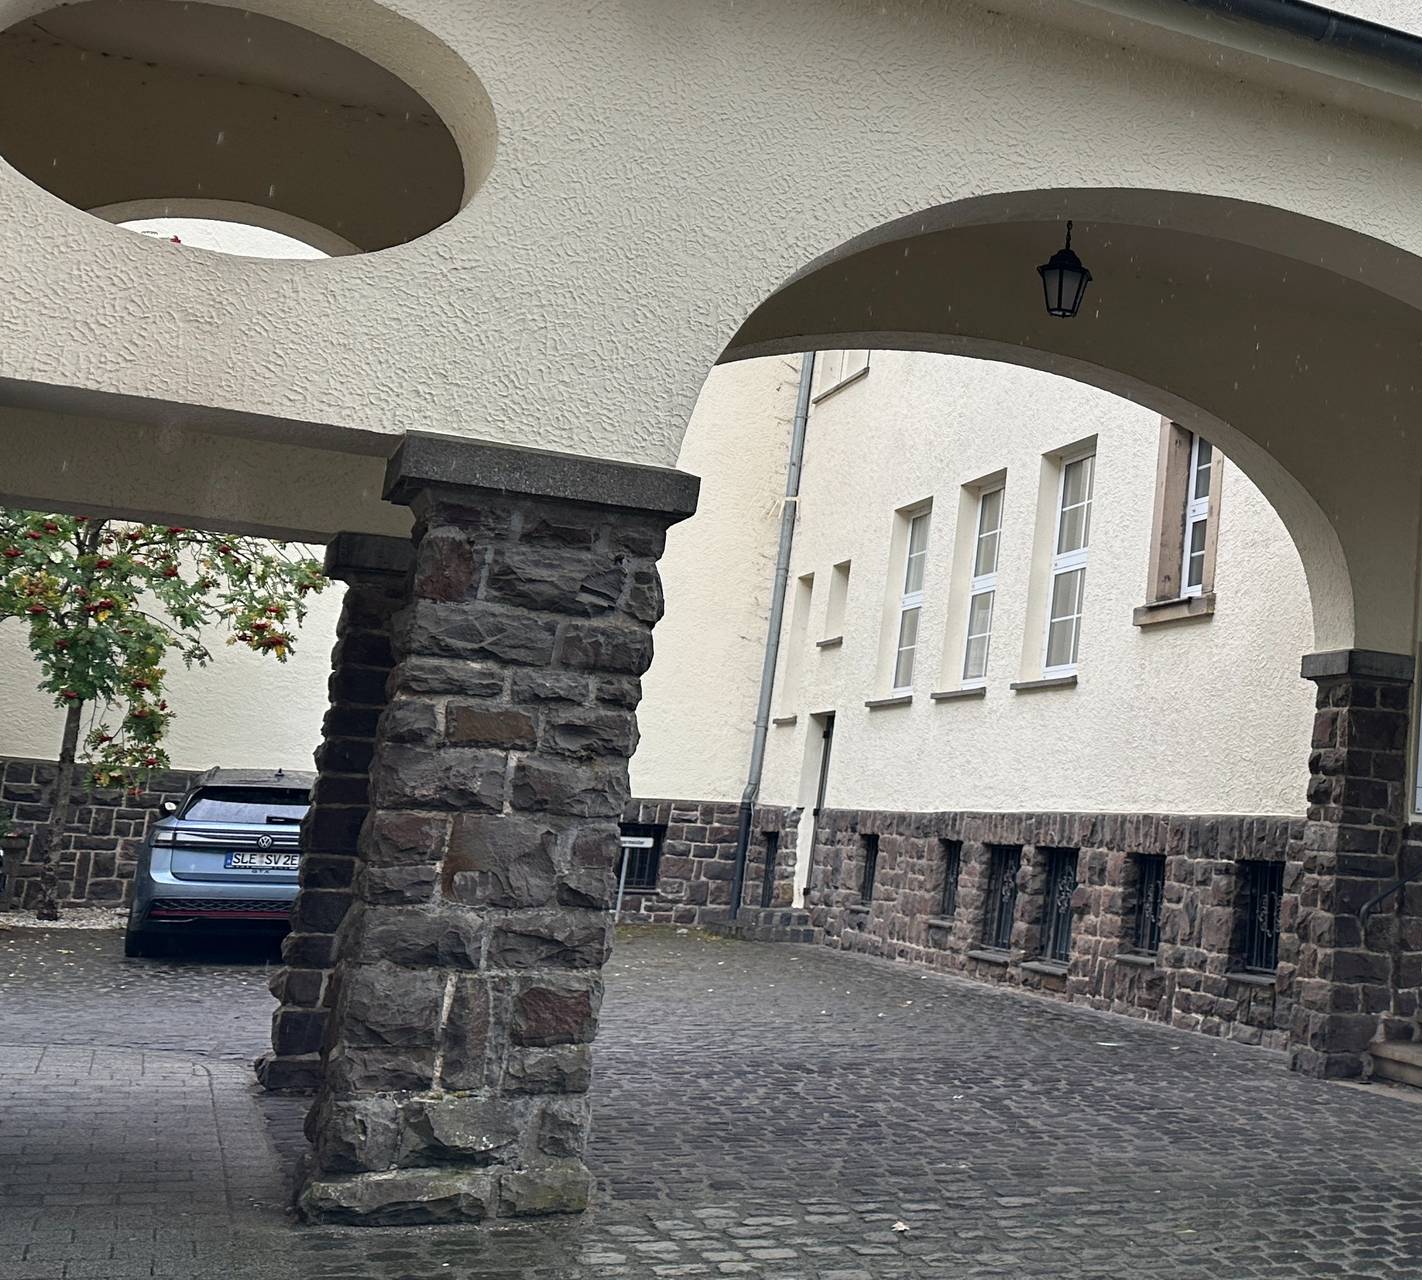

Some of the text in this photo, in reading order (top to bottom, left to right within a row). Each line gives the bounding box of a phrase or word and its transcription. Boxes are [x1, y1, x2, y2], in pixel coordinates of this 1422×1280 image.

[233, 853, 298, 865] SLE SV 2E
